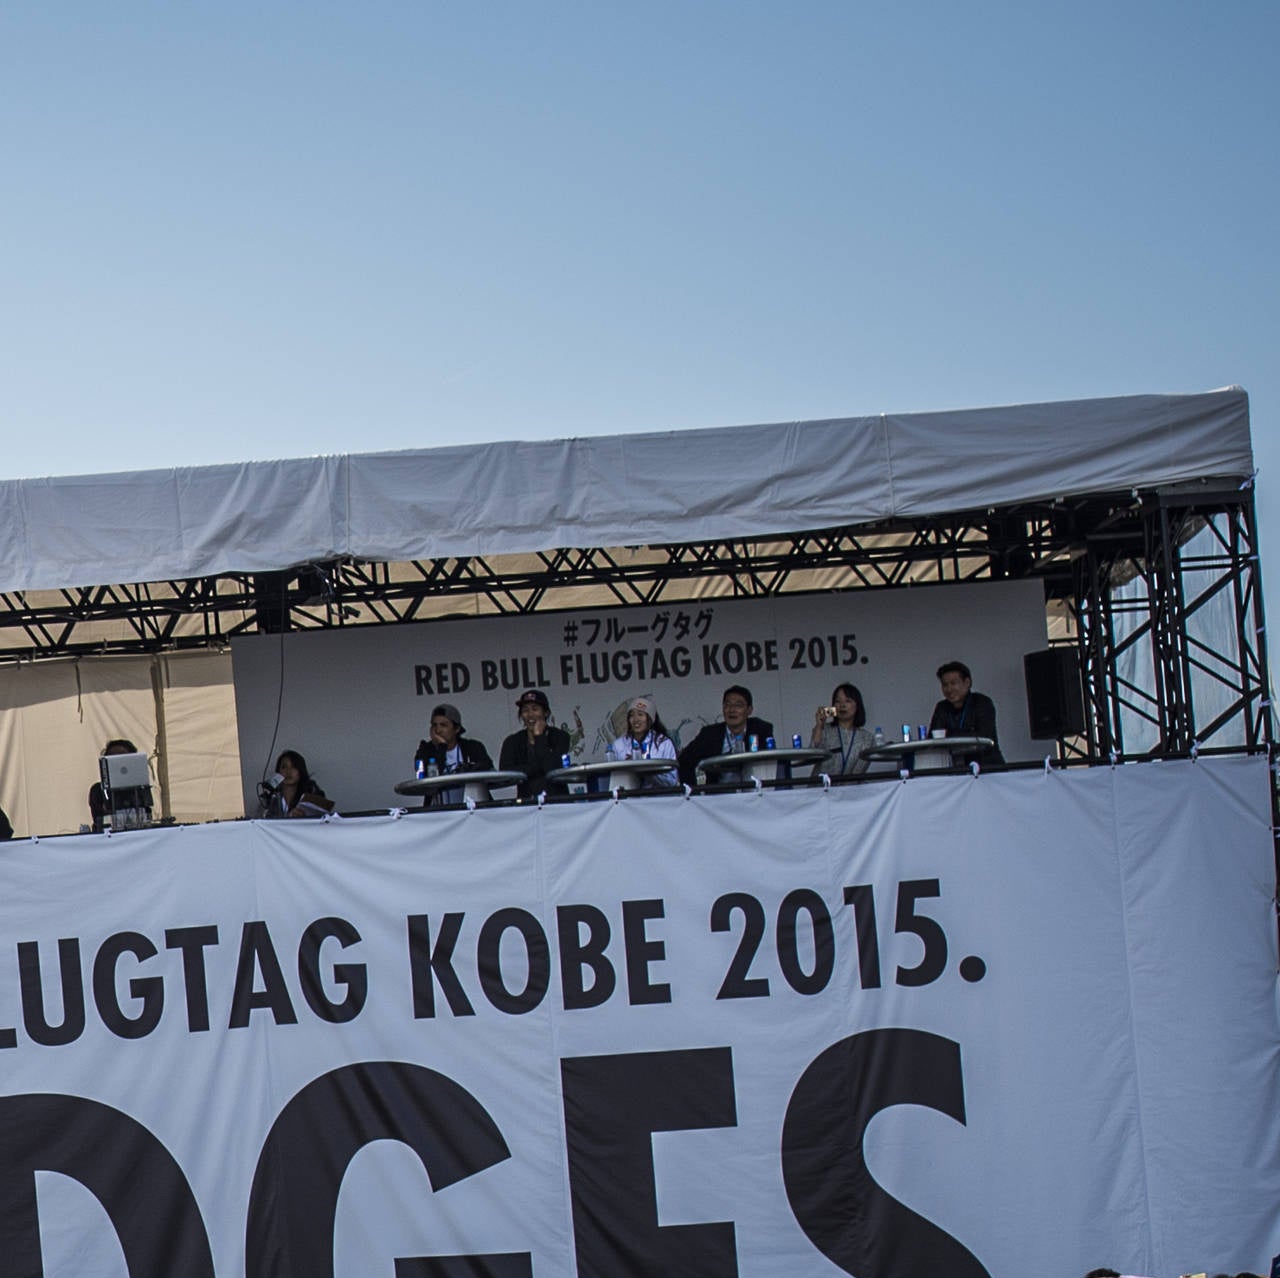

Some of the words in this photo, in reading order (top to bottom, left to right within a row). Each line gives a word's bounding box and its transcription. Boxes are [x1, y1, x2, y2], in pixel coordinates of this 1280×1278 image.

[563, 608, 715, 647] #フルーグタグ
[414, 662, 471, 696] RED
[481, 656, 551, 691] BULL
[560, 646, 692, 686] FLUGTAG
[703, 639, 779, 676] KOBE
[789, 634, 869, 670] 2015.
[407, 898, 672, 1020] KOBE
[710, 878, 987, 1001] 2015.
